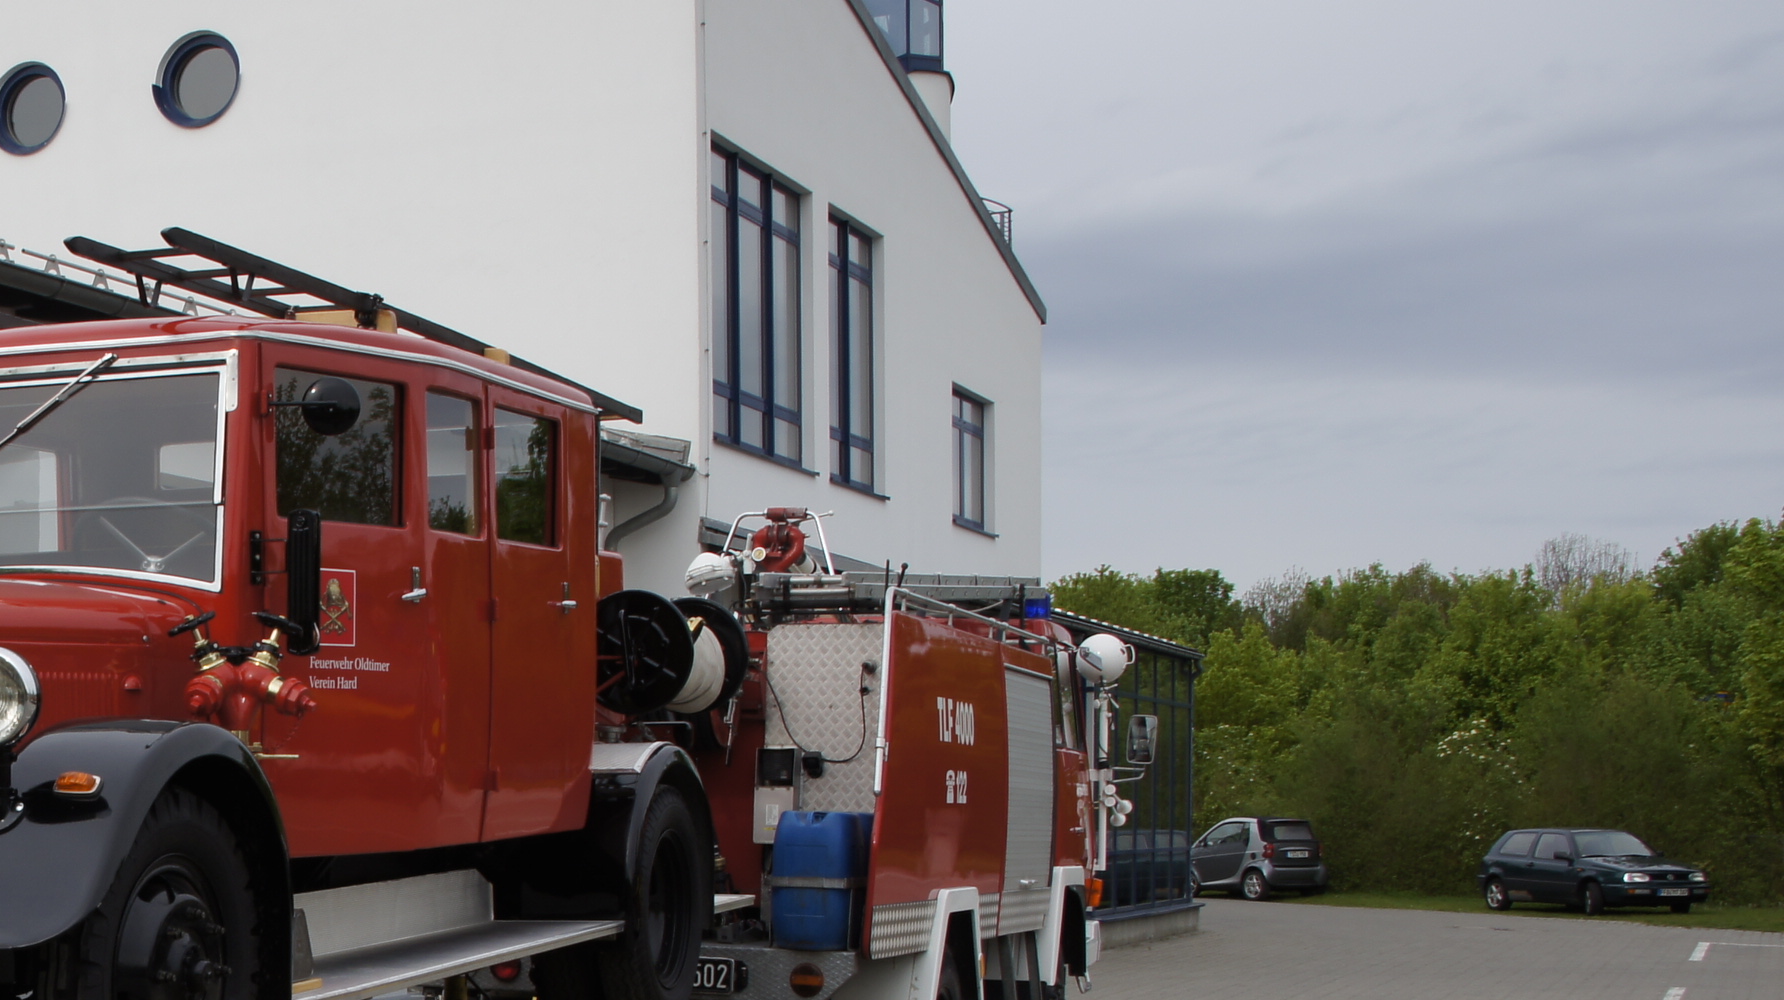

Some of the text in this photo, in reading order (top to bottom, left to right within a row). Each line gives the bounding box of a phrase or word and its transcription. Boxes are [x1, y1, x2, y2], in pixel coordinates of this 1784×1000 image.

[309, 656, 390, 672] Feuerwehr Oldtimer
[309, 676, 357, 690] Verein Hard
[937, 696, 975, 747] TLF 4000
[956, 770, 967, 804] 122
